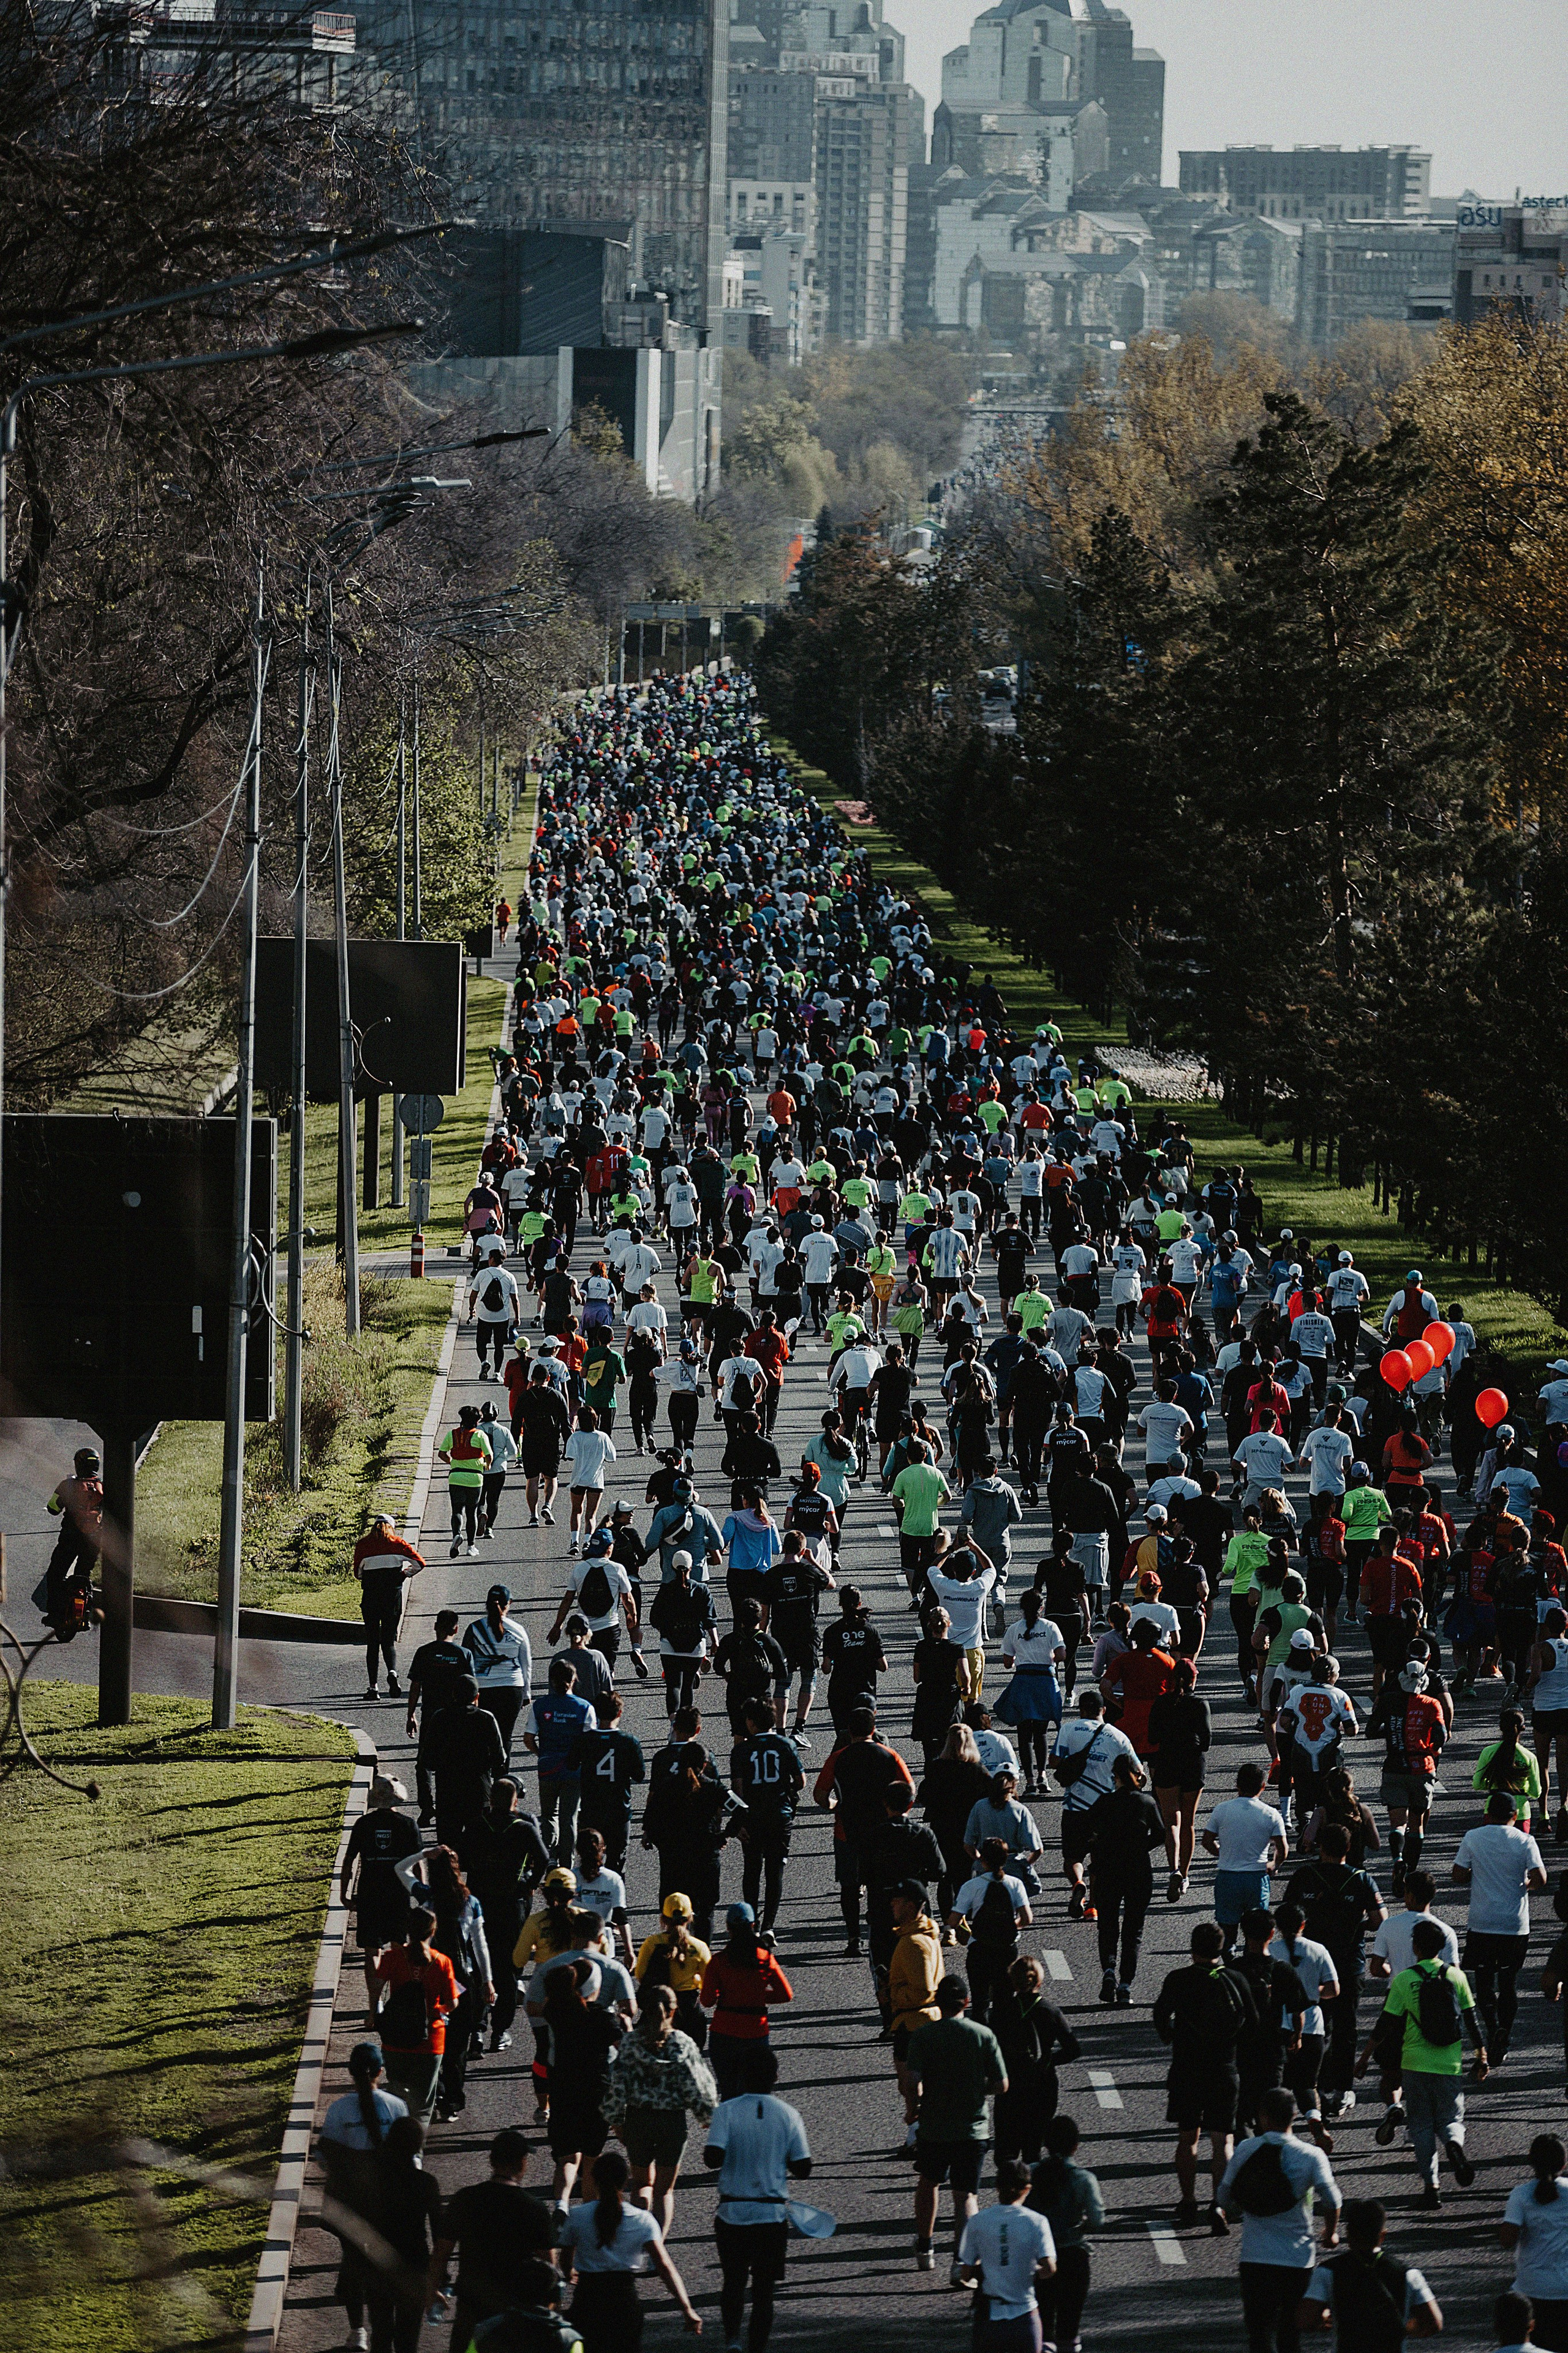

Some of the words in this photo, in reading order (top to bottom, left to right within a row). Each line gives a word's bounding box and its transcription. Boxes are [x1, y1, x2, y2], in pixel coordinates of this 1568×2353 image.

[609, 1153, 619, 1169] 11
[842, 1631, 865, 1640] one
[842, 1639, 865, 1648] team
[596, 1748, 615, 1782] 4
[749, 1750, 780, 1784] 10
